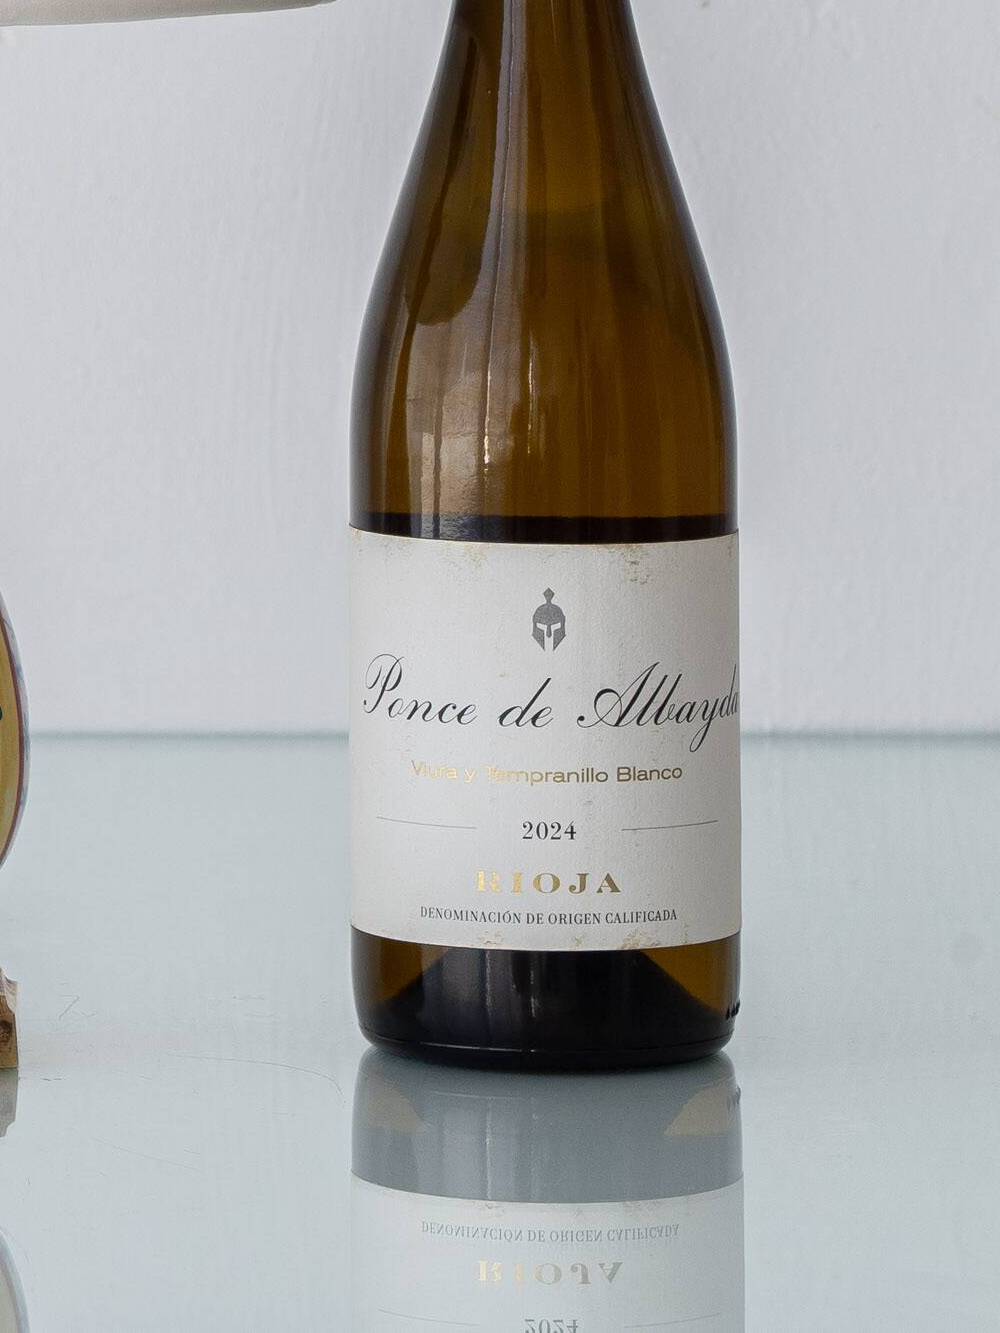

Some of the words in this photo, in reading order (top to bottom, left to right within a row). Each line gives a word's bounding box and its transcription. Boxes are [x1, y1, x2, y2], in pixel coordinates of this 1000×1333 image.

[363, 653, 478, 725] Ponce
[498, 677, 554, 728] de
[463, 766, 476, 783] y
[487, 764, 609, 787] Tempranillo
[616, 766, 684, 782] Blanco
[521, 820, 577, 841] 2024
[475, 869, 622, 895] RIOJA
[420, 905, 522, 925] DENOMINACIÓN
[526, 912, 544, 925] DE
[547, 911, 602, 926] ORIGEN
[605, 908, 678, 925] CALIFICADA
